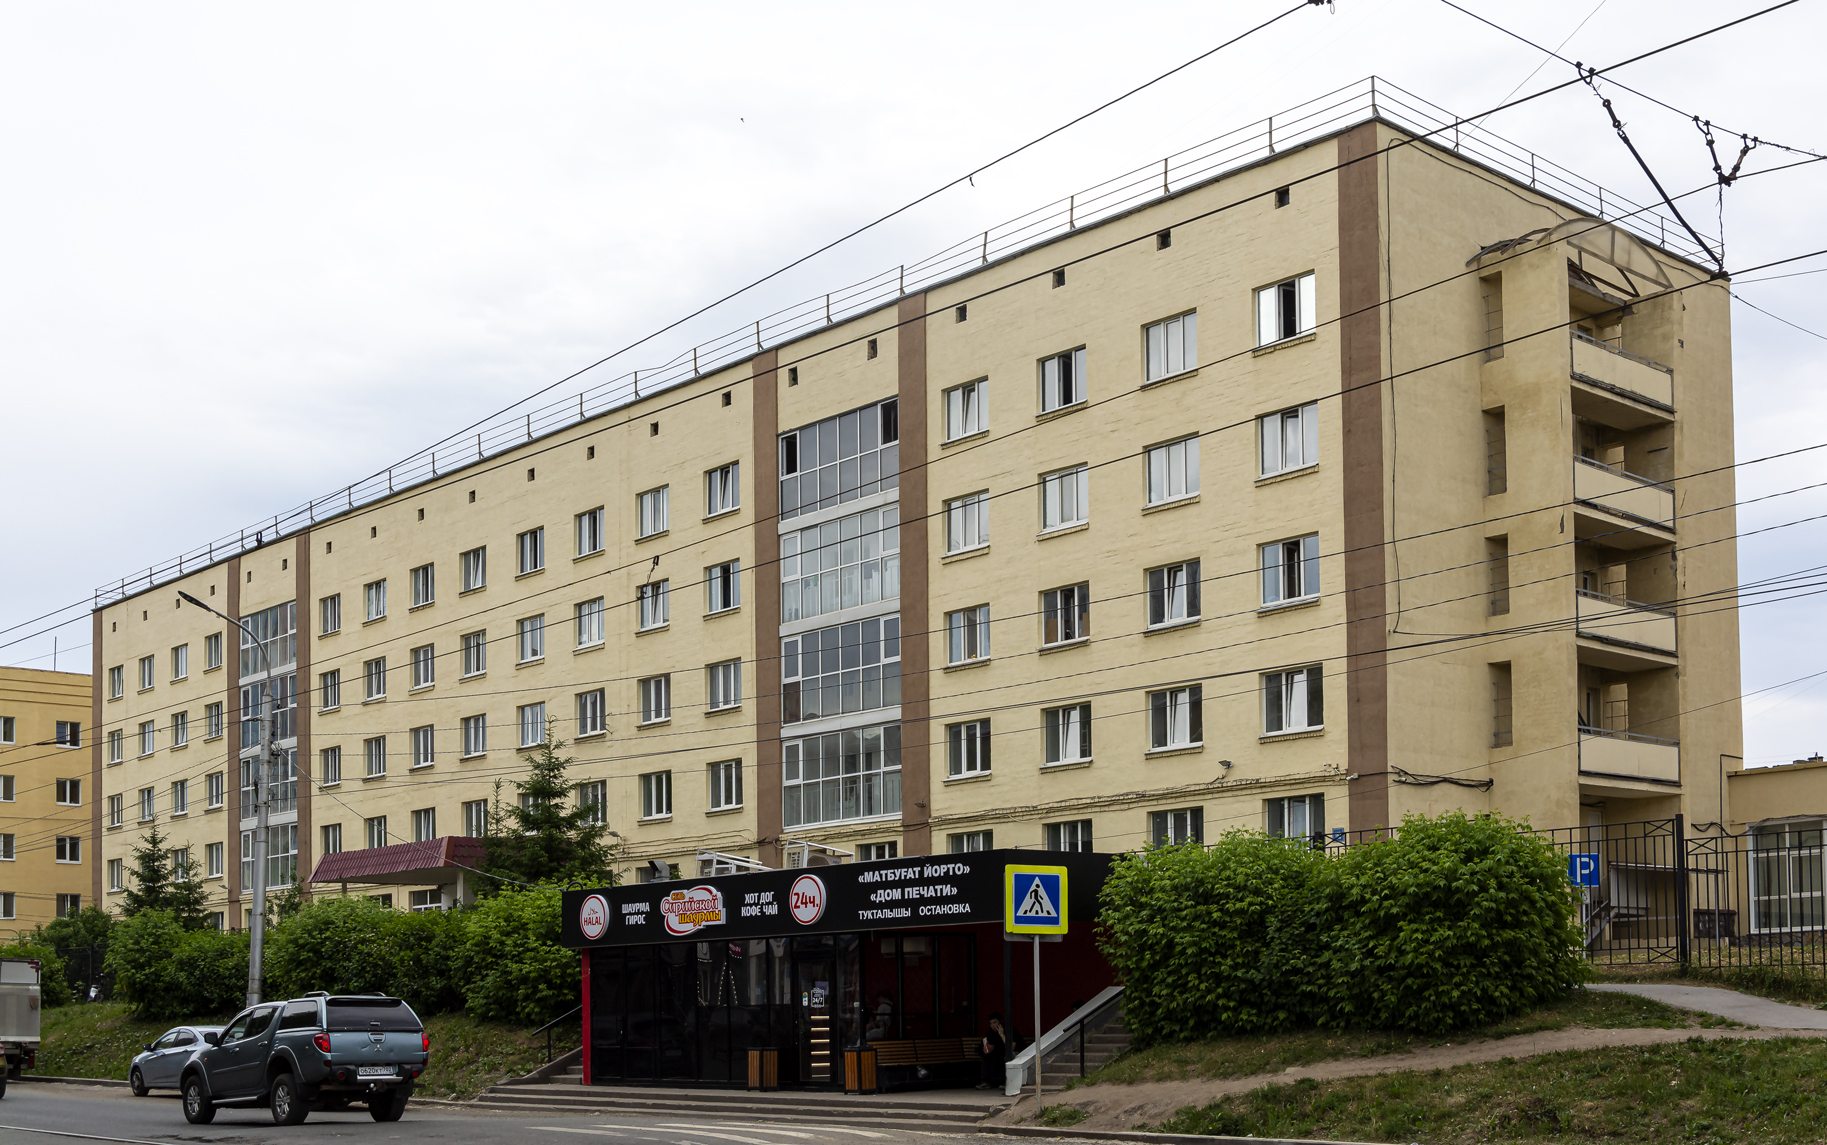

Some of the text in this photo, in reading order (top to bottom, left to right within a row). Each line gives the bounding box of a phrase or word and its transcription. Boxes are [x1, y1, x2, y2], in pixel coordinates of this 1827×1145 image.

[923, 863, 970, 878] ЙОРТО»
[744, 891, 775, 905] ХОТ ДОГ
[793, 891, 819, 910] 24ч.
[870, 884, 958, 903] «ДОМ ПЕЧАТИ»
[621, 902, 650, 914] ШАУРМА
[661, 895, 719, 917] Сирийской
[741, 901, 778, 917] КОФЕ ЧАЙ
[919, 903, 971, 916] ОСТАНОВКА
[583, 916, 602, 926] HALAL
[625, 914, 646, 925] ГИРОС
[678, 910, 722, 927] шаурмы
